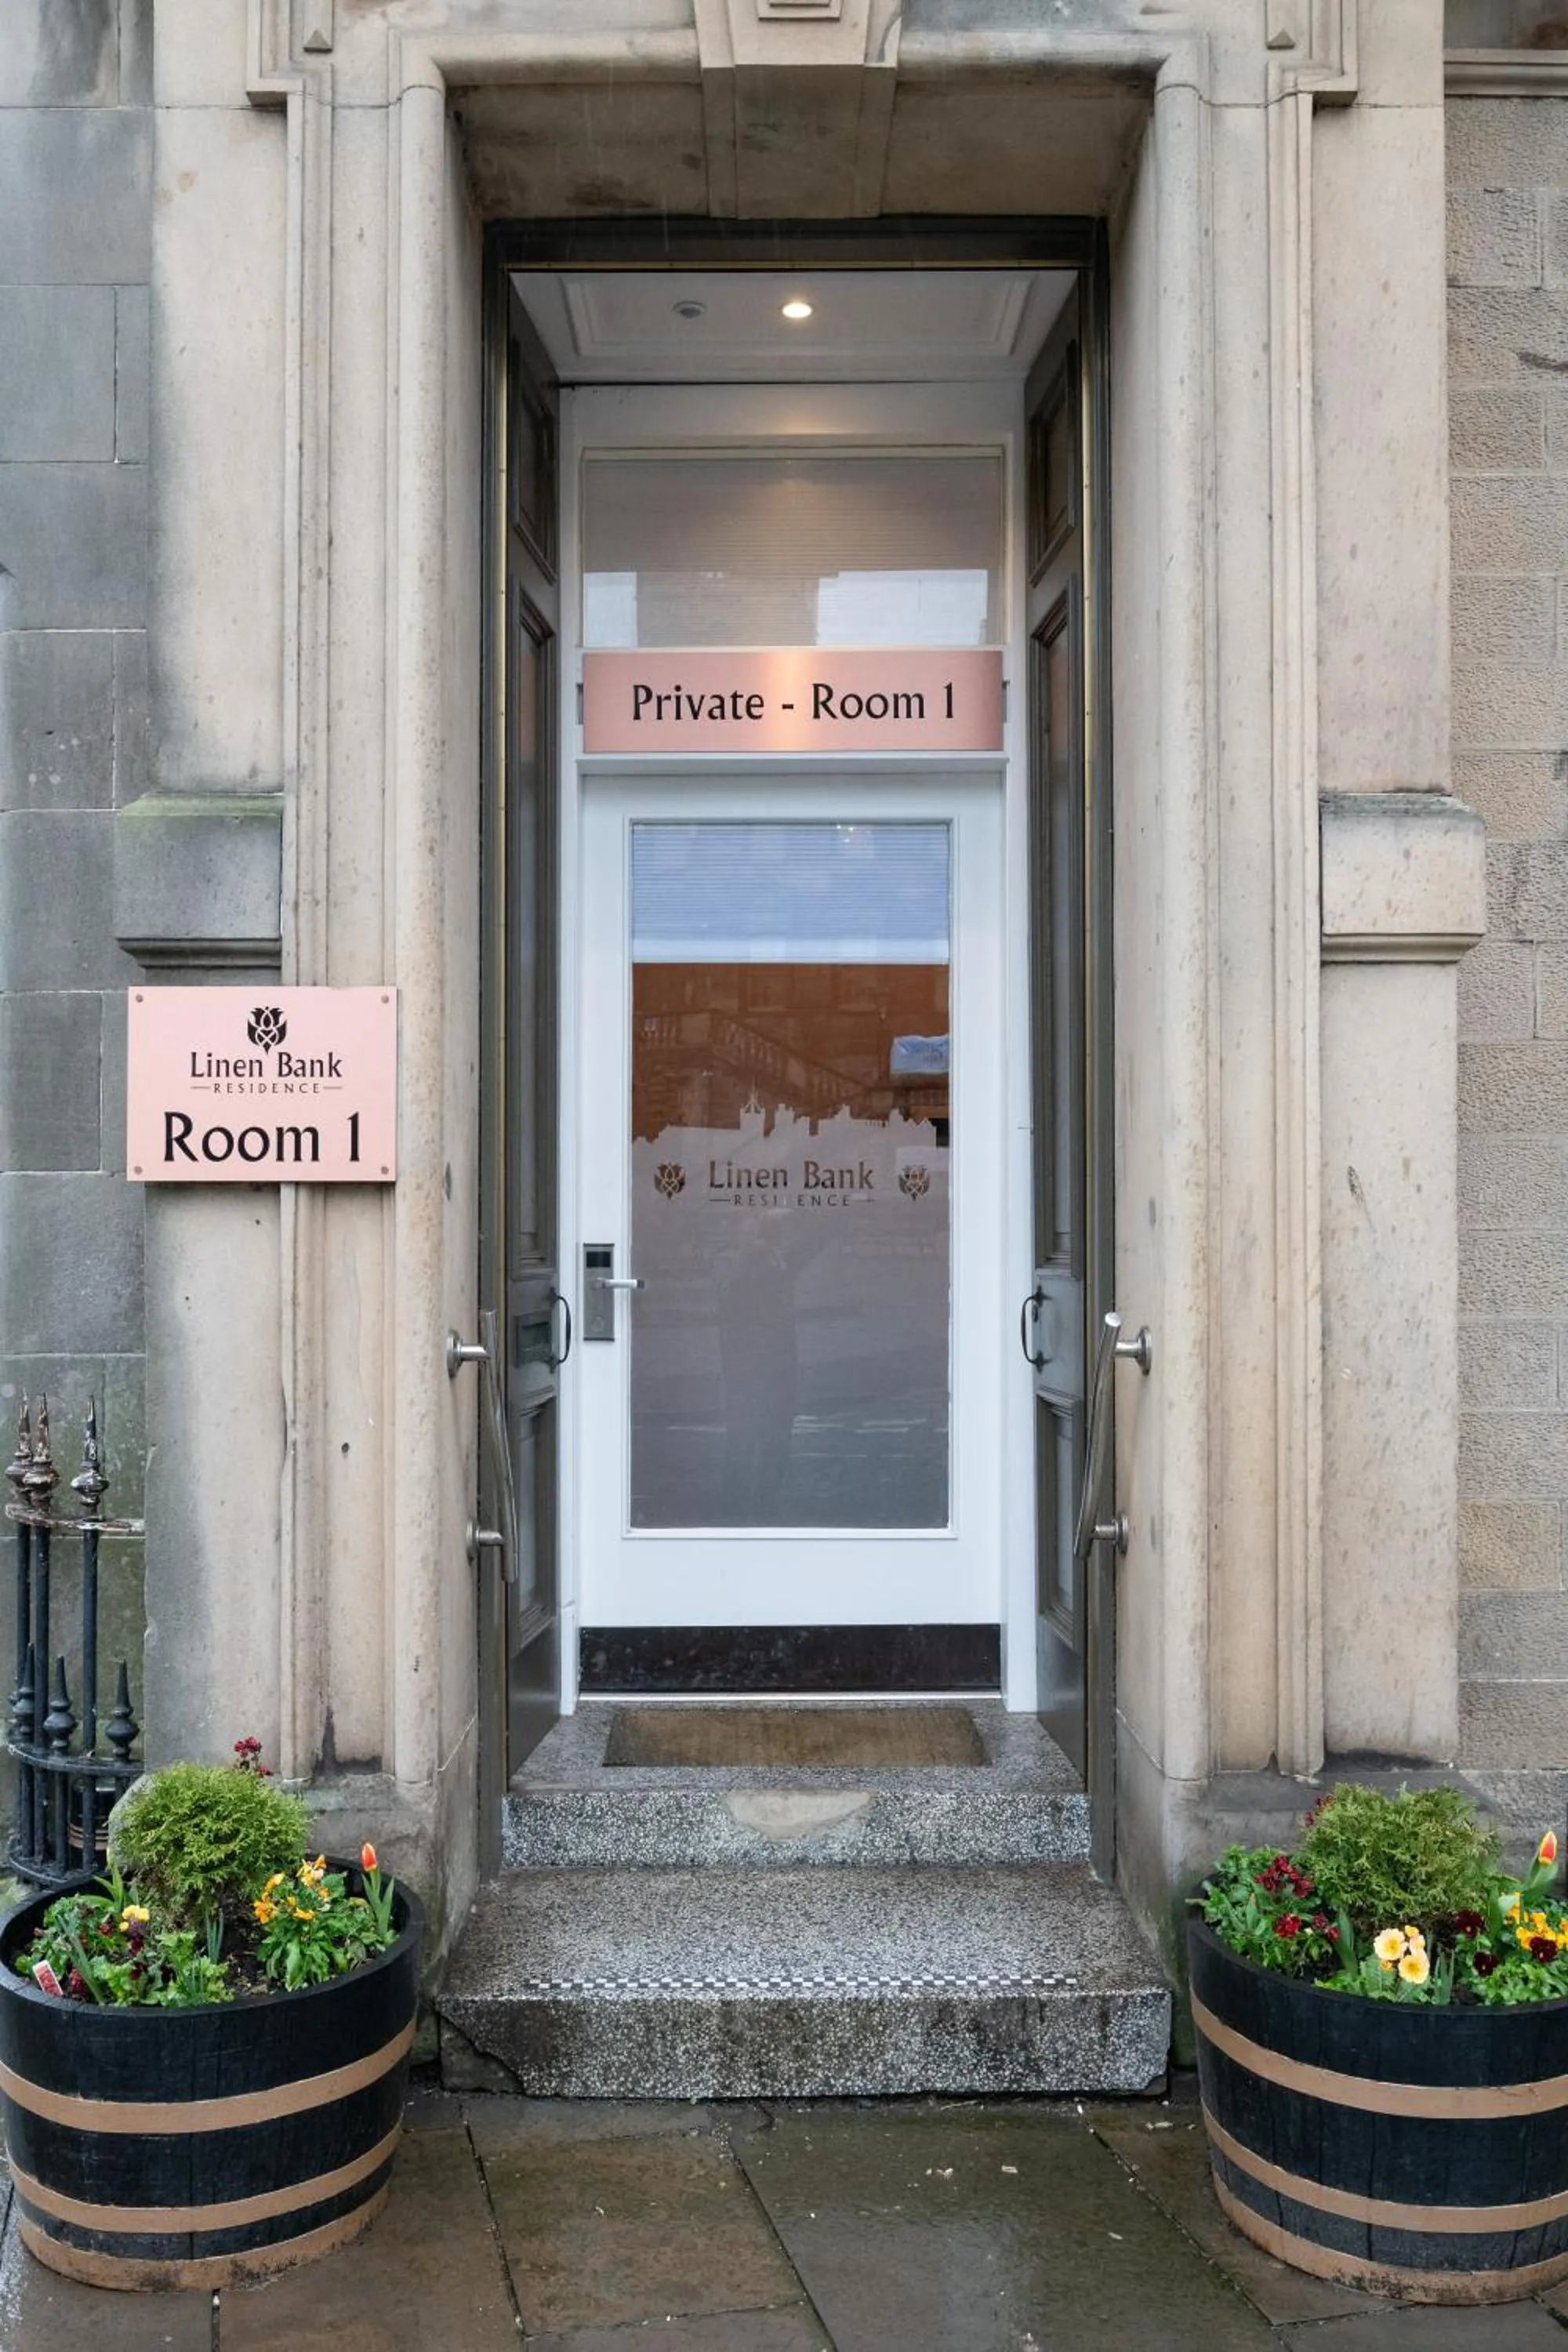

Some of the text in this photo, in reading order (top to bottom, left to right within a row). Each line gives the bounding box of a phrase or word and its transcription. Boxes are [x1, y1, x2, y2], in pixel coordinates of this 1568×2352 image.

[632, 684, 765, 720] Private
[811, 682, 926, 720] Room
[944, 681, 954, 719] 1
[191, 1051, 343, 1079] Linen Bank
[213, 1083, 320, 1094] RESIDENCE
[163, 1111, 361, 1163] Room 1
[709, 1160, 875, 1190] Linen Bank
[734, 1193, 851, 1207] RESIENCE
